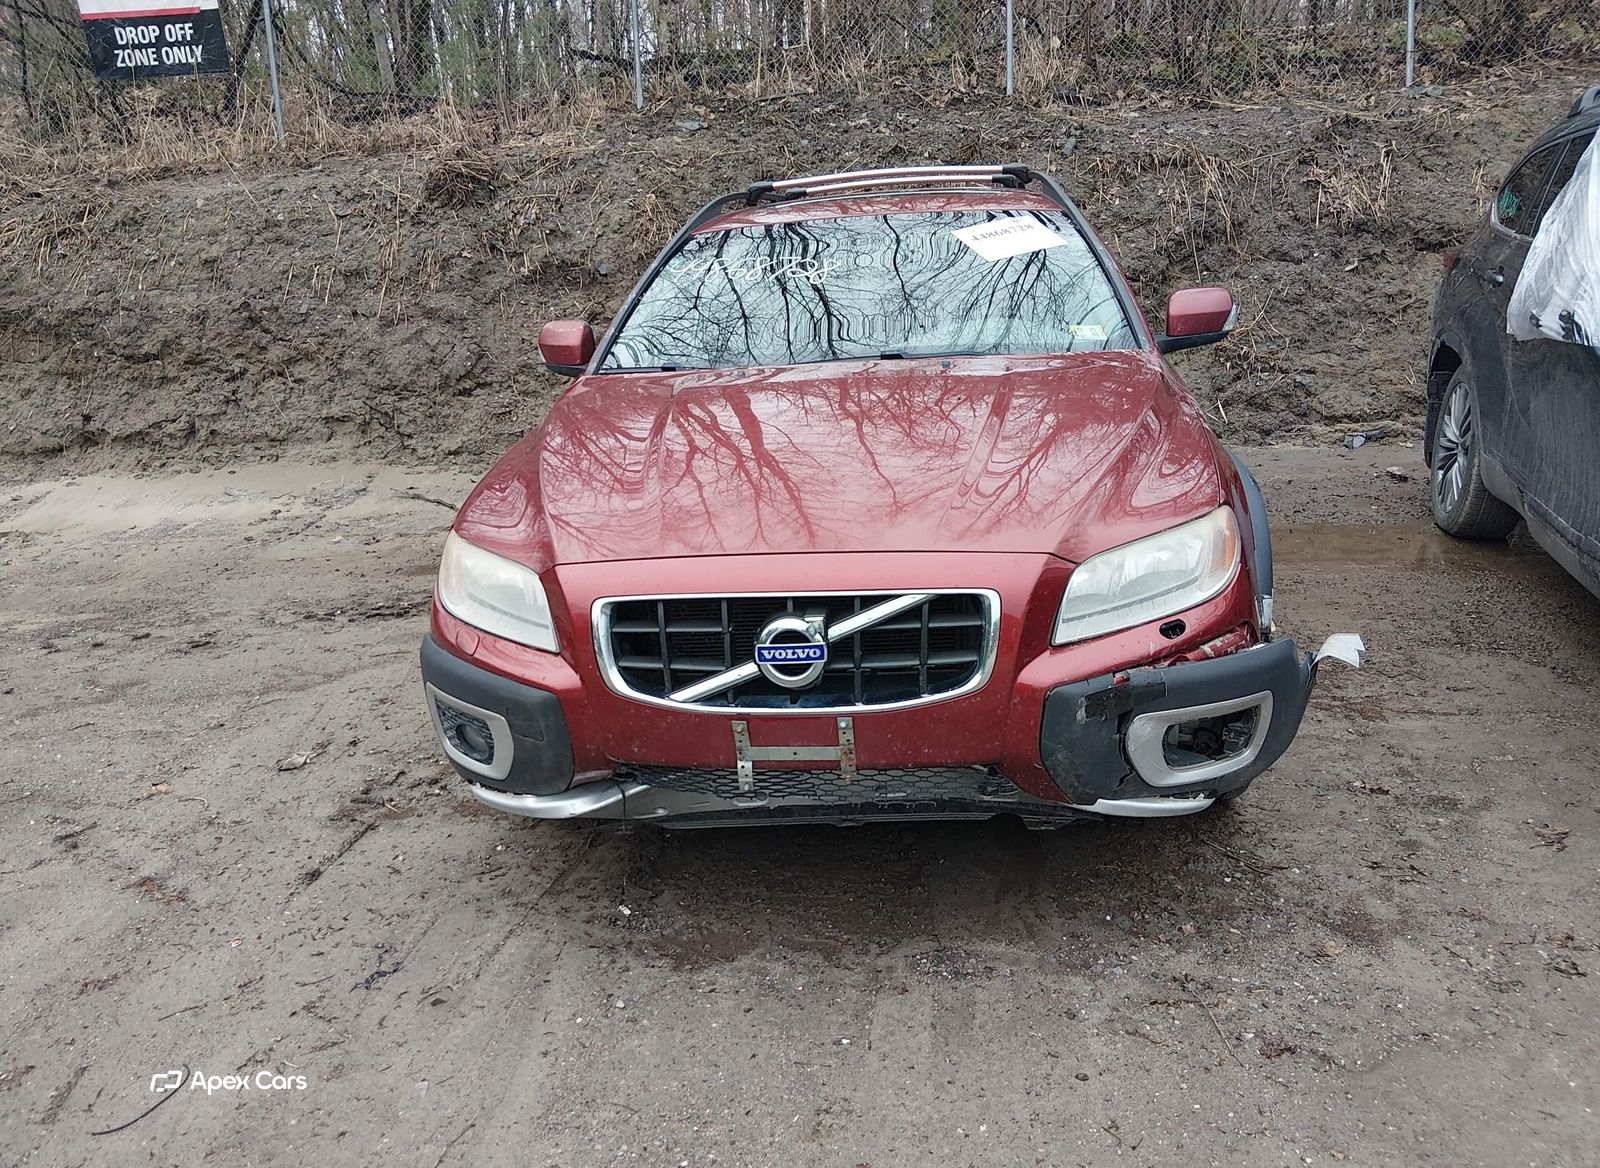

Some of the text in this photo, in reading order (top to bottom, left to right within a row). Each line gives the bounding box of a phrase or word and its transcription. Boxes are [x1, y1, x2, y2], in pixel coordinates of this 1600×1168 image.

[114, 23, 194, 45] DROP OFF
[113, 44, 203, 68] ZONE ONLY
[971, 223, 1035, 242] 44868728
[760, 648, 821, 660] VOLVO
